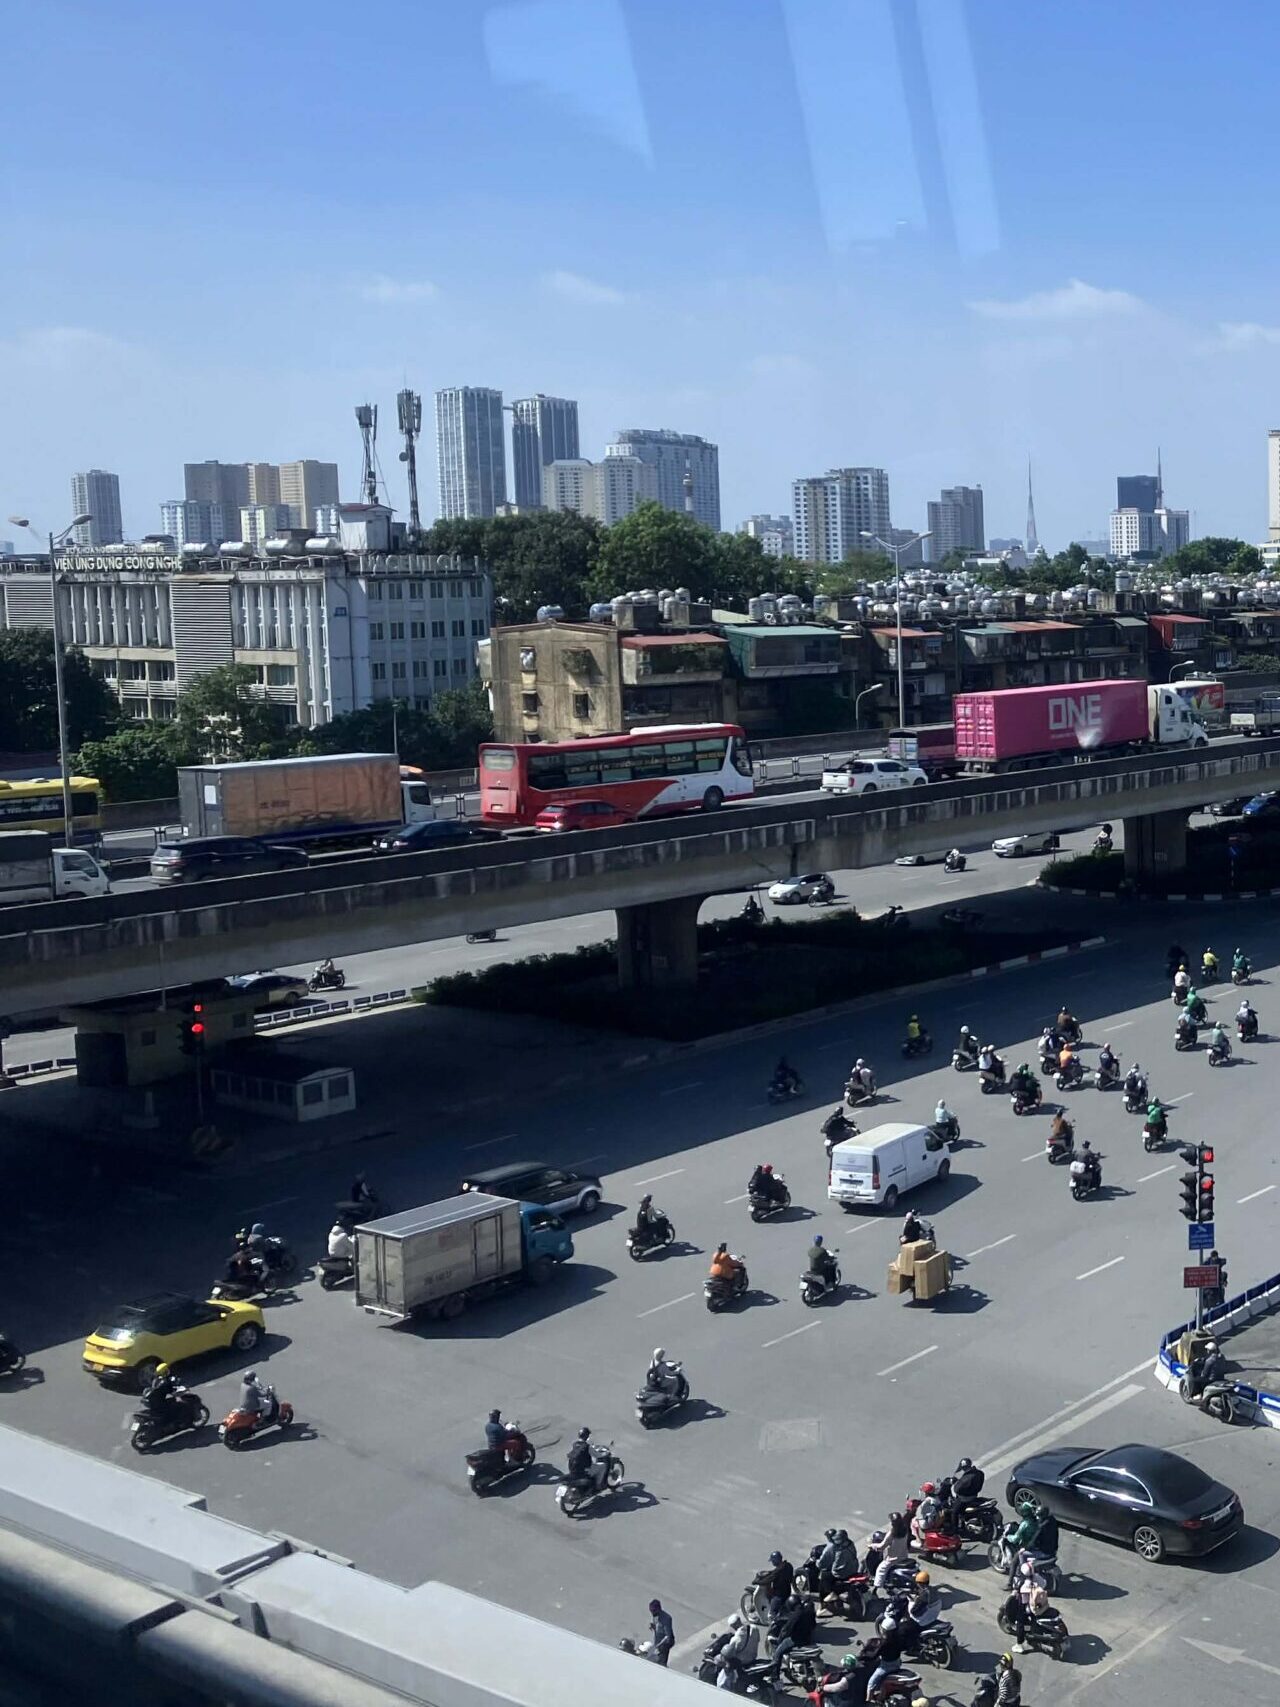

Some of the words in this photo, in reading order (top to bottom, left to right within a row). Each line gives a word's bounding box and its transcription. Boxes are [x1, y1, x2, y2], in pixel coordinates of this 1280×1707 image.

[54, 556, 74, 571] VIỆN
[97, 557, 123, 572] DỤNG
[125, 554, 154, 570] CÔNG
[1049, 695, 1101, 730] ONE
